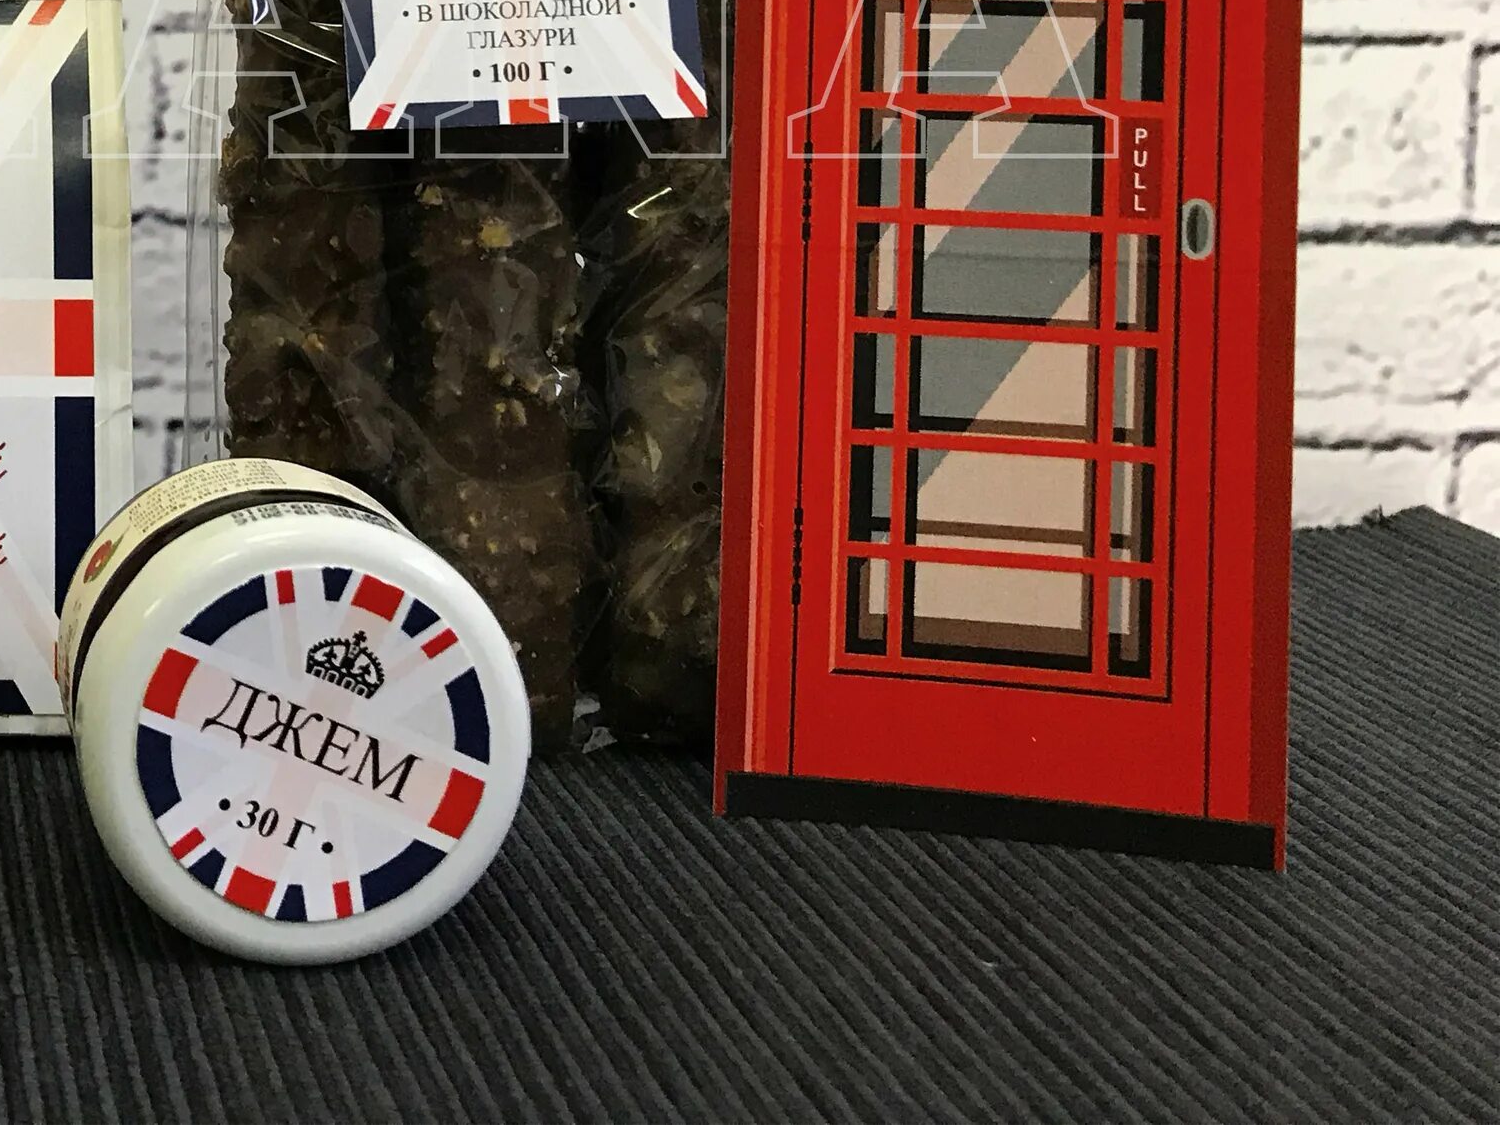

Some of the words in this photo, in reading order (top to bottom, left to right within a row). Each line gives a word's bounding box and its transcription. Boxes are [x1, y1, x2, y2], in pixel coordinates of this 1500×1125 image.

[417, 4, 433, 22] В
[466, 27, 576, 49] ГЛАЗУРИ
[490, 61, 530, 83] 100
[538, 60, 556, 81] Г
[1133, 127, 1148, 212] PULL
[200, 677, 423, 804] ДЖЕМ
[236, 800, 280, 838] 30
[283, 818, 316, 850] Г
